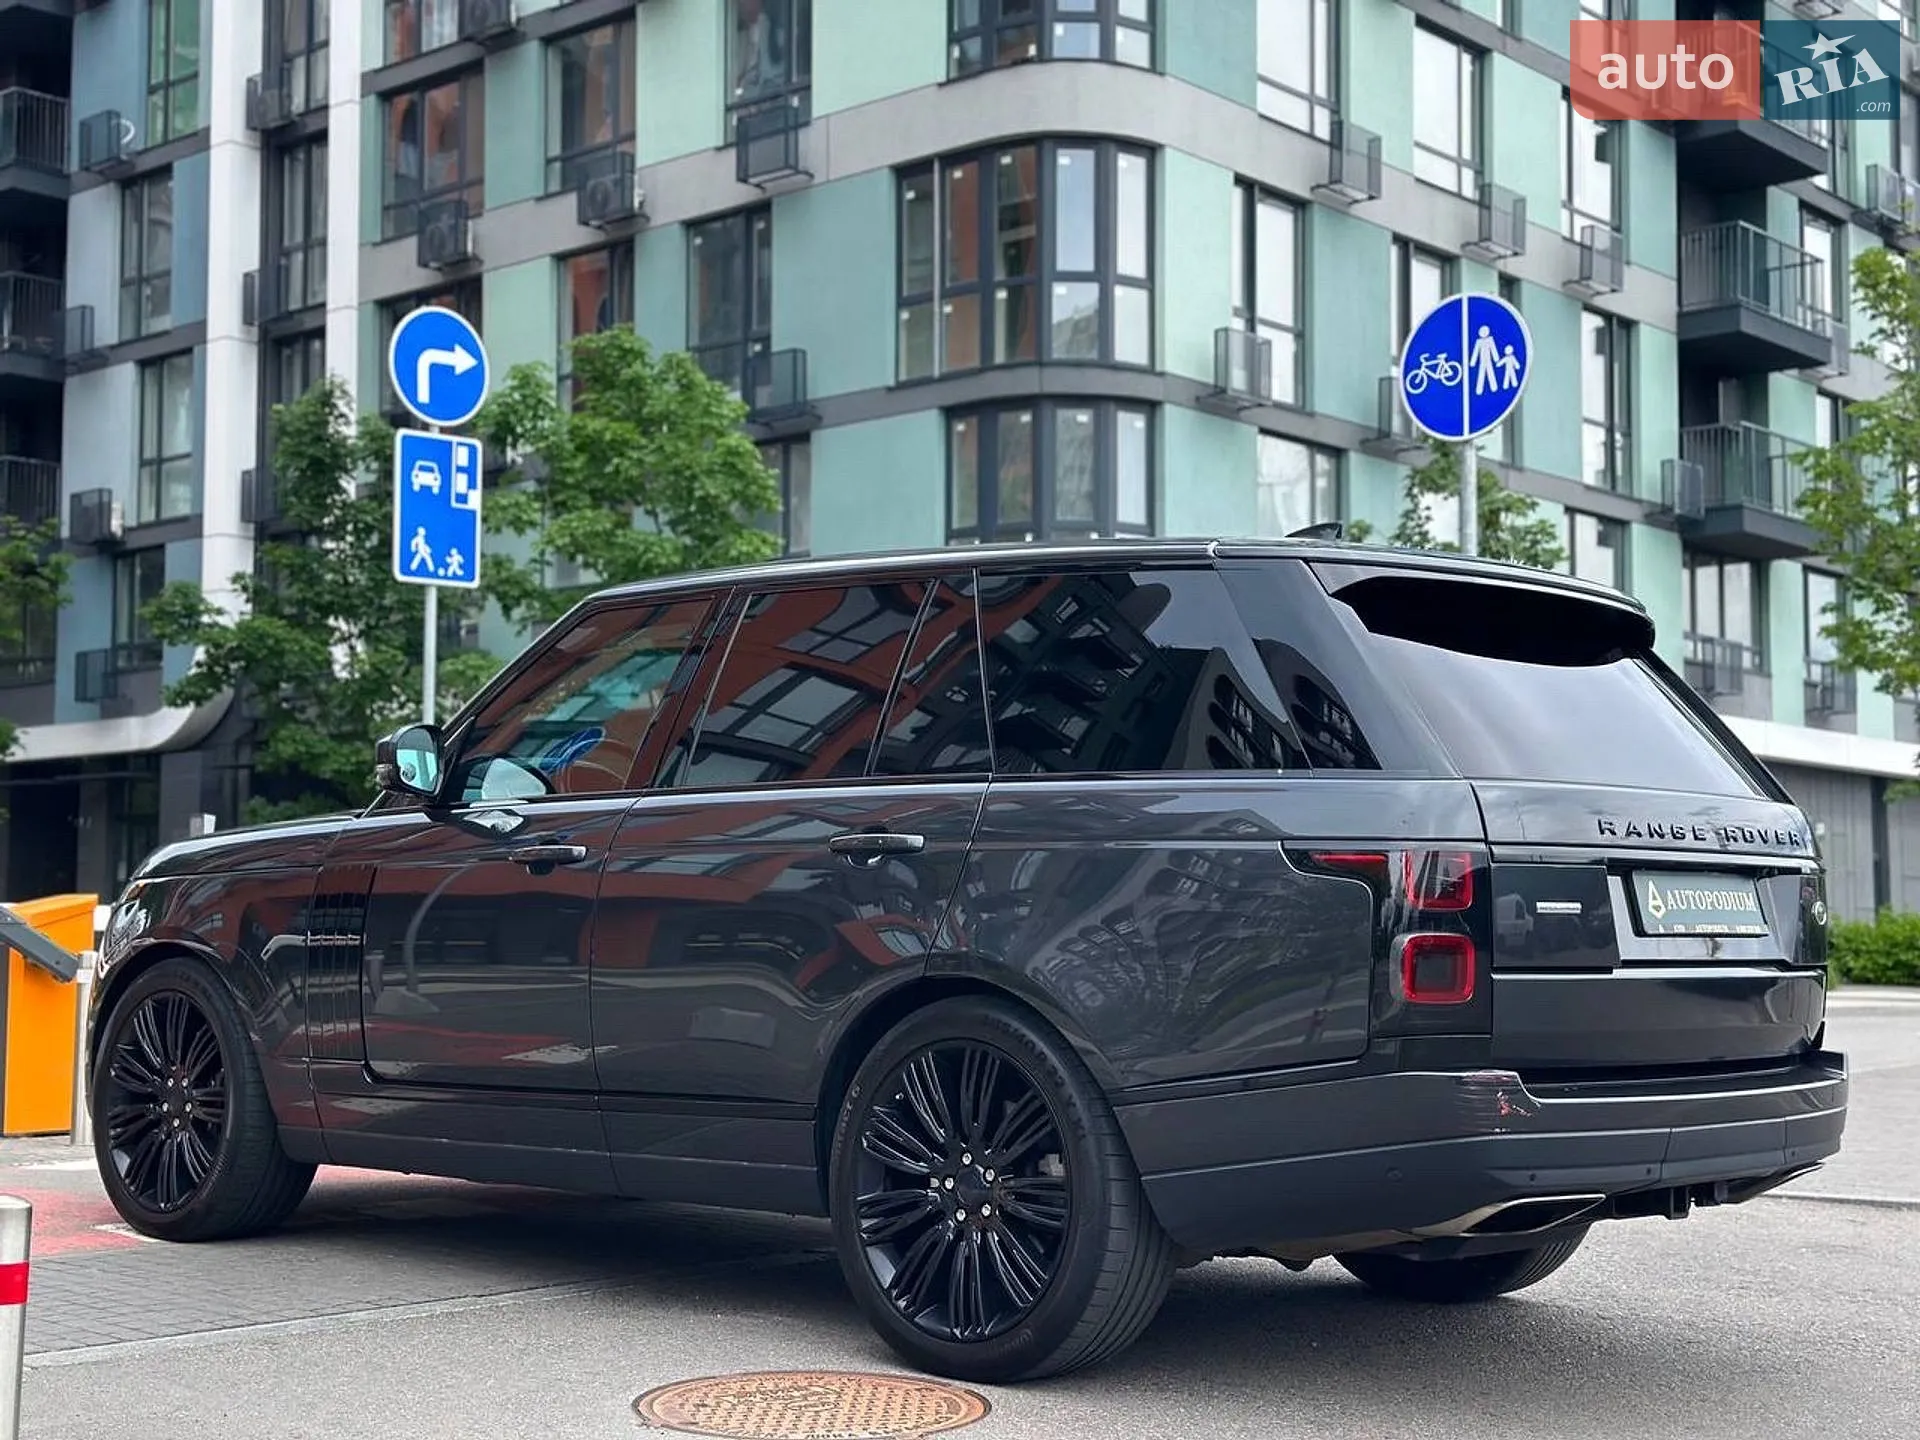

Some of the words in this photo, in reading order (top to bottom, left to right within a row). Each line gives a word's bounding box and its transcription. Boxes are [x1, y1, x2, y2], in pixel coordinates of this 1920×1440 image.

[1597, 818, 1708, 842] RANGE
[1723, 825, 1801, 847] ROVER
[1666, 888, 1758, 912] AUTOPODIUM
